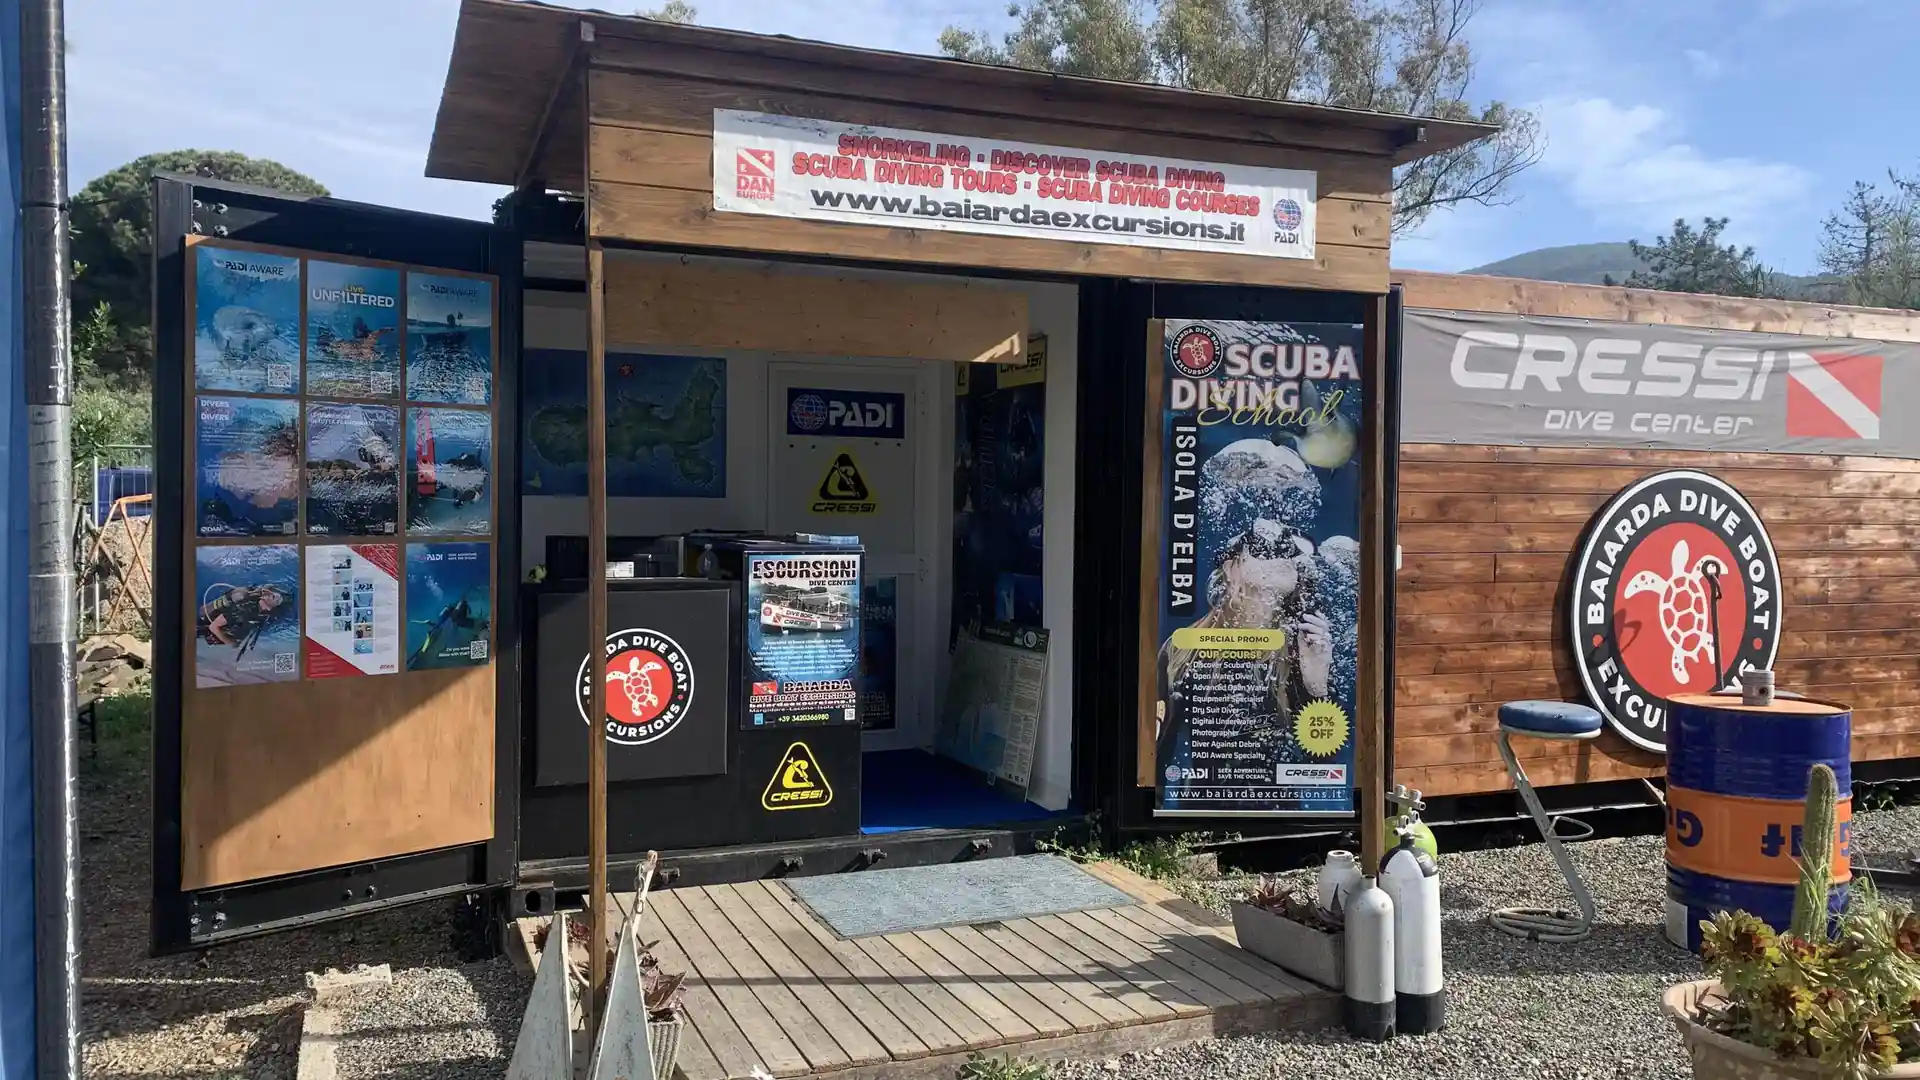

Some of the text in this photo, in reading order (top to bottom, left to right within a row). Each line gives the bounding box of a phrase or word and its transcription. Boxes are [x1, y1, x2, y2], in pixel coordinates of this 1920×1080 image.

[837, 133, 1226, 192] SNORKELING DISCOVER SCUBA DIVING
[736, 175, 775, 194] DAN
[792, 152, 1260, 217] SCUBA DIVING TOURS SCUBA DIVING COURSES
[736, 189, 775, 201] EUROPE
[810, 189, 1245, 242] www.baiardaexcursions.it
[1274, 231, 1299, 244] PADI
[225, 261, 284, 276] PADI AWARE
[312, 289, 395, 308] UNFILTERED
[1173, 327, 1220, 355] BAIARDA DIVE BOAT
[1176, 360, 1217, 375] EXCURSIONS
[1225, 343, 1360, 381] SCUBA
[1449, 330, 1776, 401] CRESSI
[1171, 378, 1299, 412] DIVING
[1197, 386, 1344, 426] School
[828, 400, 894, 429] PADI
[812, 502, 876, 513] CRESSI
[1171, 426, 1197, 607] ISOLA D'ELBA
[1587, 489, 1770, 630] BAIARDA DIVE BOAT
[752, 560, 857, 579] ESCURSIONI
[1199, 635, 1235, 643] SPECIAL
[632, 635, 669, 654] DIVE
[667, 652, 688, 692] BOAT
[1193, 661, 1222, 669] Discover
[1223, 661, 1245, 669] Scuba
[783, 679, 852, 693] BAIARDA
[750, 695, 772, 704] DIVE
[799, 692, 856, 701] EXCURSIONS
[1192, 695, 1229, 703] Equipment
[1192, 706, 1205, 715] Dry
[1206, 706, 1220, 714] Suit
[606, 703, 681, 738] CURSIONS
[1192, 718, 1215, 726] Digital
[1309, 716, 1335, 727] 25%
[1192, 729, 1240, 738] Photographer
[1310, 728, 1334, 739] OFF
[1192, 740, 1261, 749] Diver Against Debris
[1233, 752, 1266, 761] Specialty
[1181, 768, 1209, 780] PADI
[1285, 769, 1330, 777] CRESSI
[770, 789, 824, 802] CRESSI
[1169, 789, 1343, 799] www.baiardaexcursions.it
